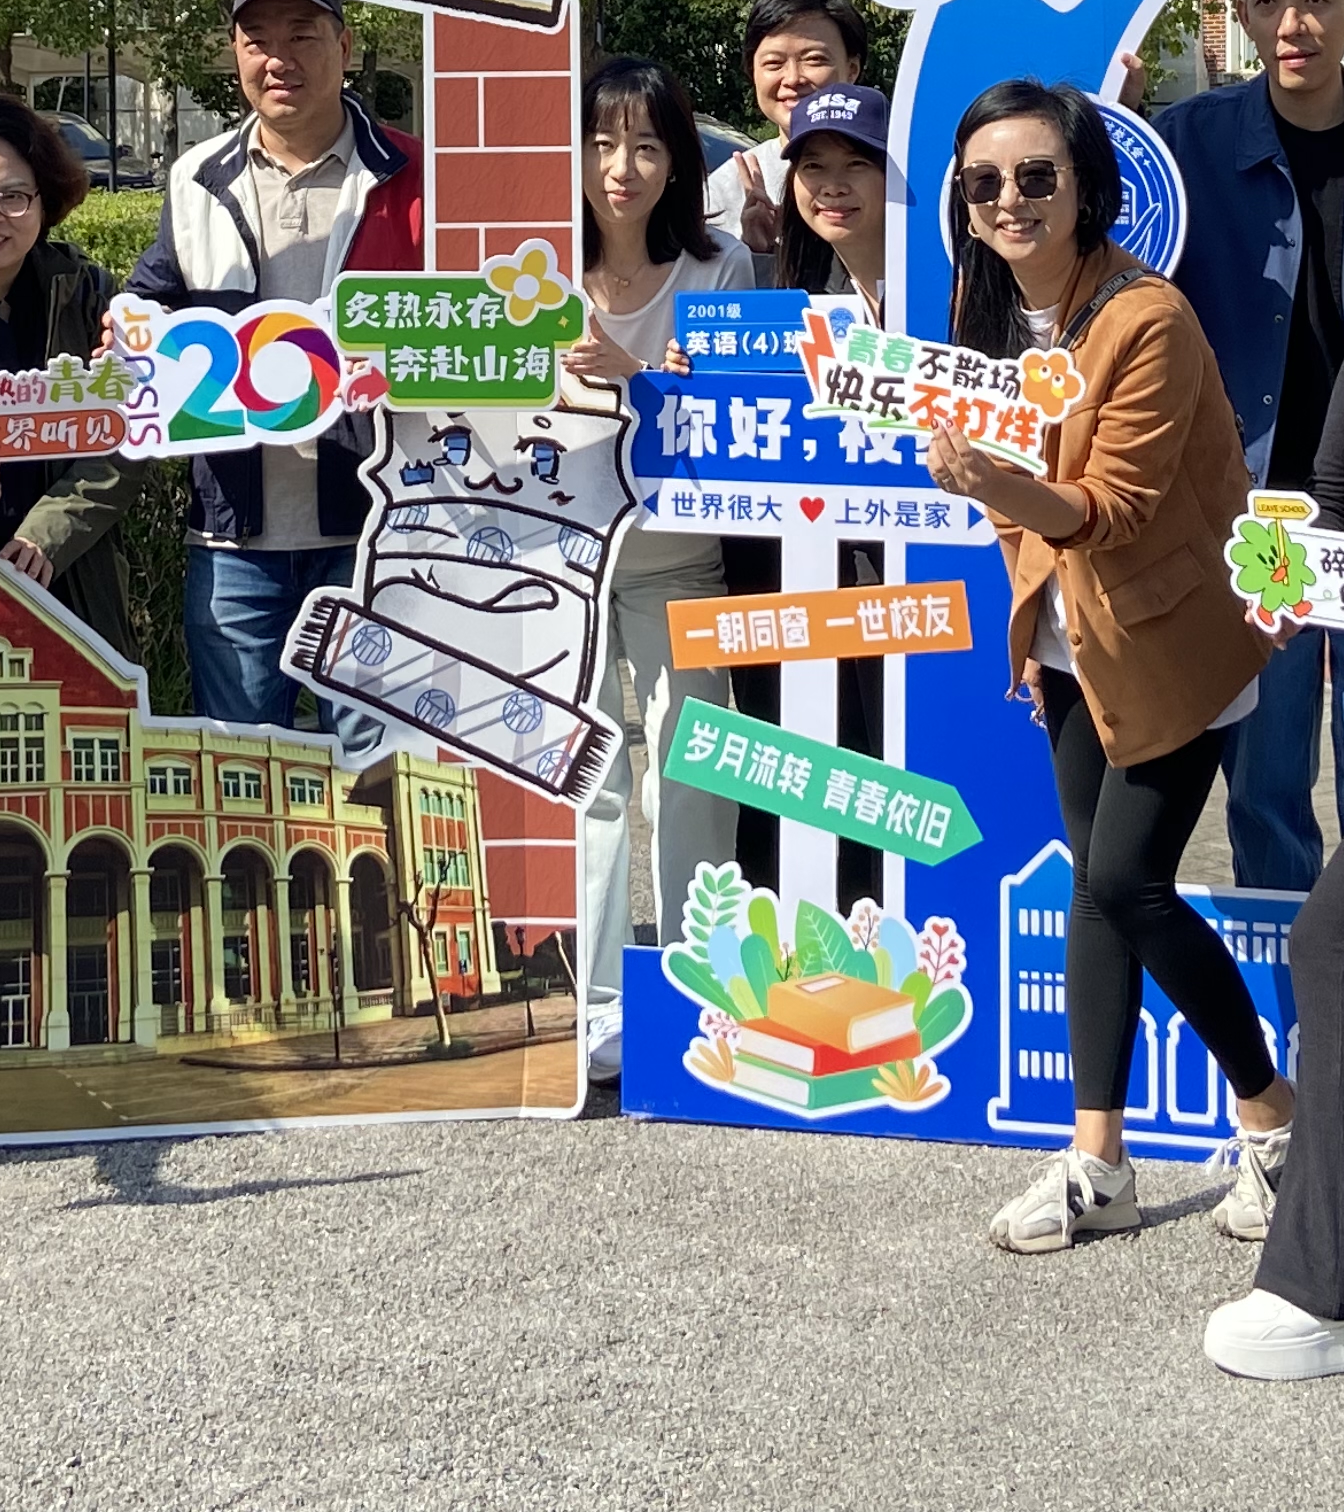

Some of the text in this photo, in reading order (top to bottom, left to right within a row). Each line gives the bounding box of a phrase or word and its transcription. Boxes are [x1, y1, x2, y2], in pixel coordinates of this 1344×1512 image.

[343, 291, 504, 329] 炙热永存
[687, 303, 743, 319] 2001级
[390, 344, 551, 382] 奔赴山海
[848, 327, 1022, 401] 青春不散场
[825, 364, 1040, 453] 快乐不打烊
[671, 491, 952, 530] 世界很大 上外是家
[685, 594, 955, 654] 一朝同窗 一世校友
[683, 719, 953, 849] 岁月流转 青春依旧
